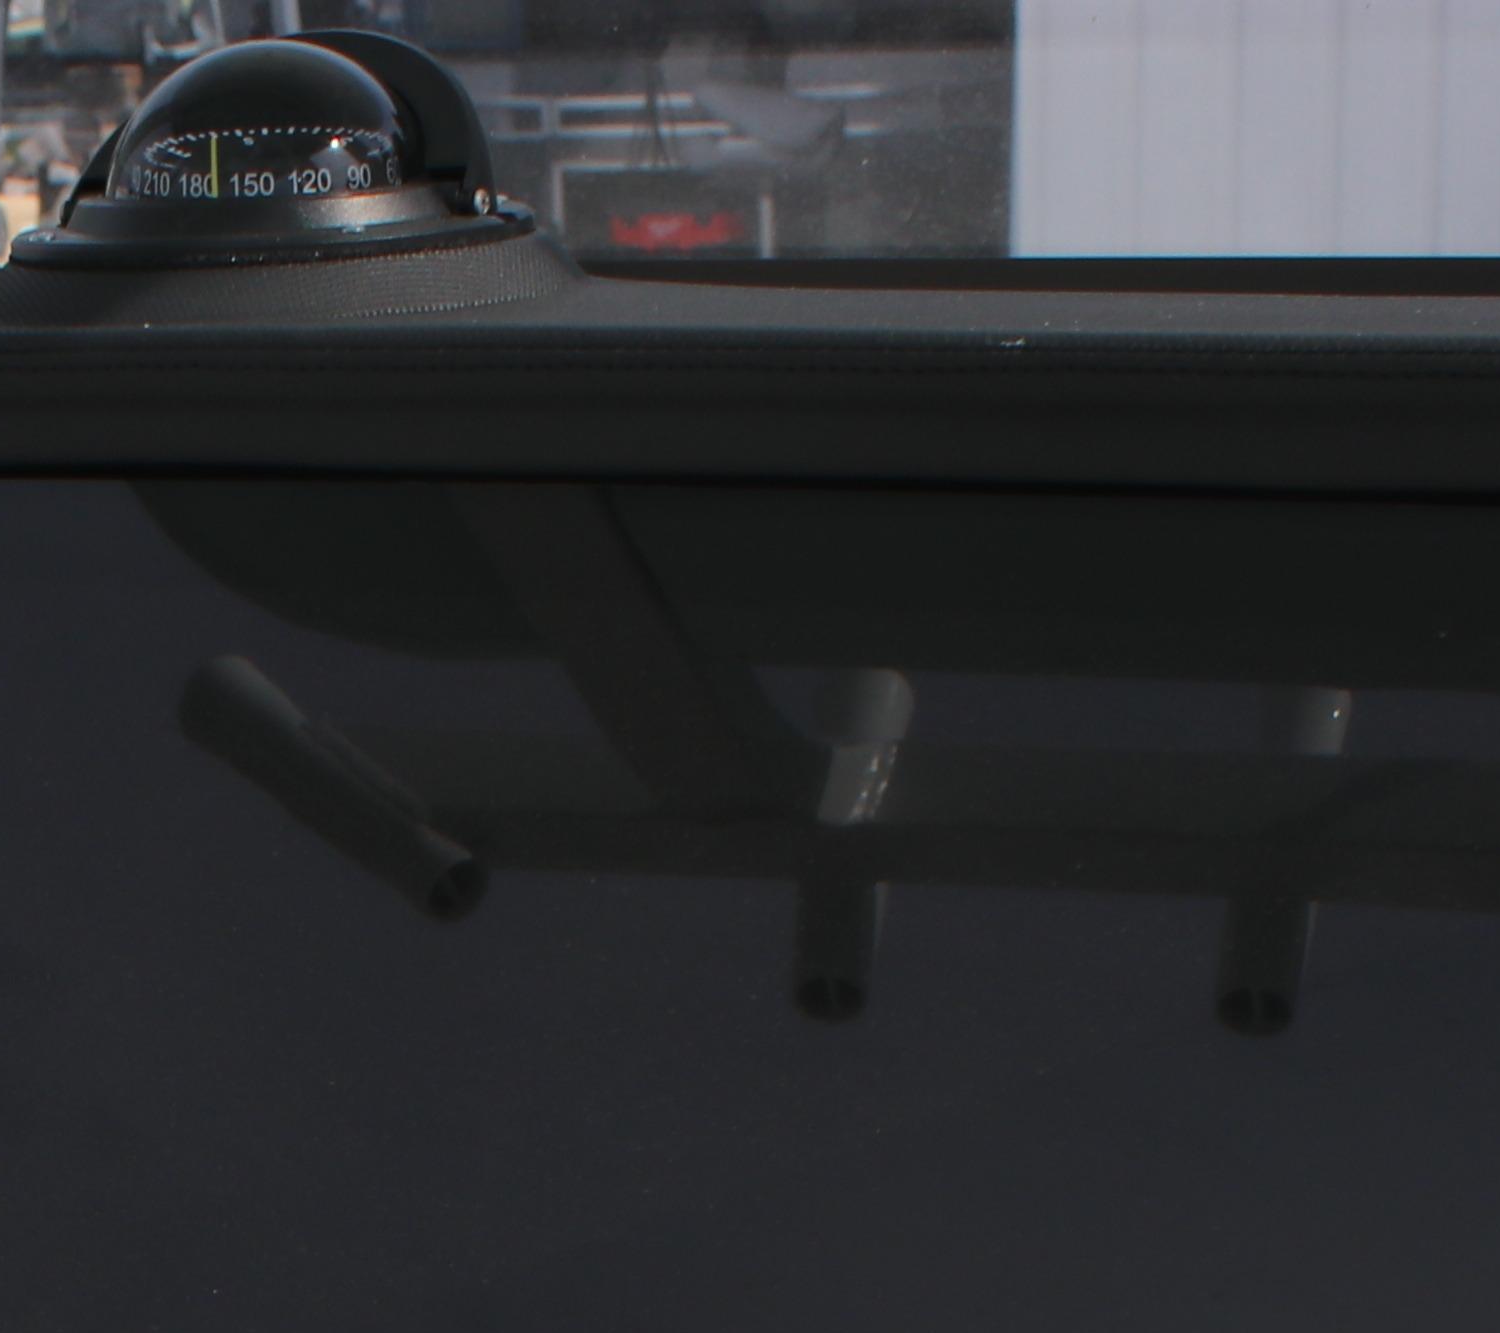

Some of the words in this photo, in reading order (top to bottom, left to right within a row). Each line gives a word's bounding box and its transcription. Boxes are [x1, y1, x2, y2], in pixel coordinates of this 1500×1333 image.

[143, 171, 170, 196] 210
[229, 172, 275, 197] 150
[287, 167, 332, 195] 120
[349, 163, 371, 189] 90
